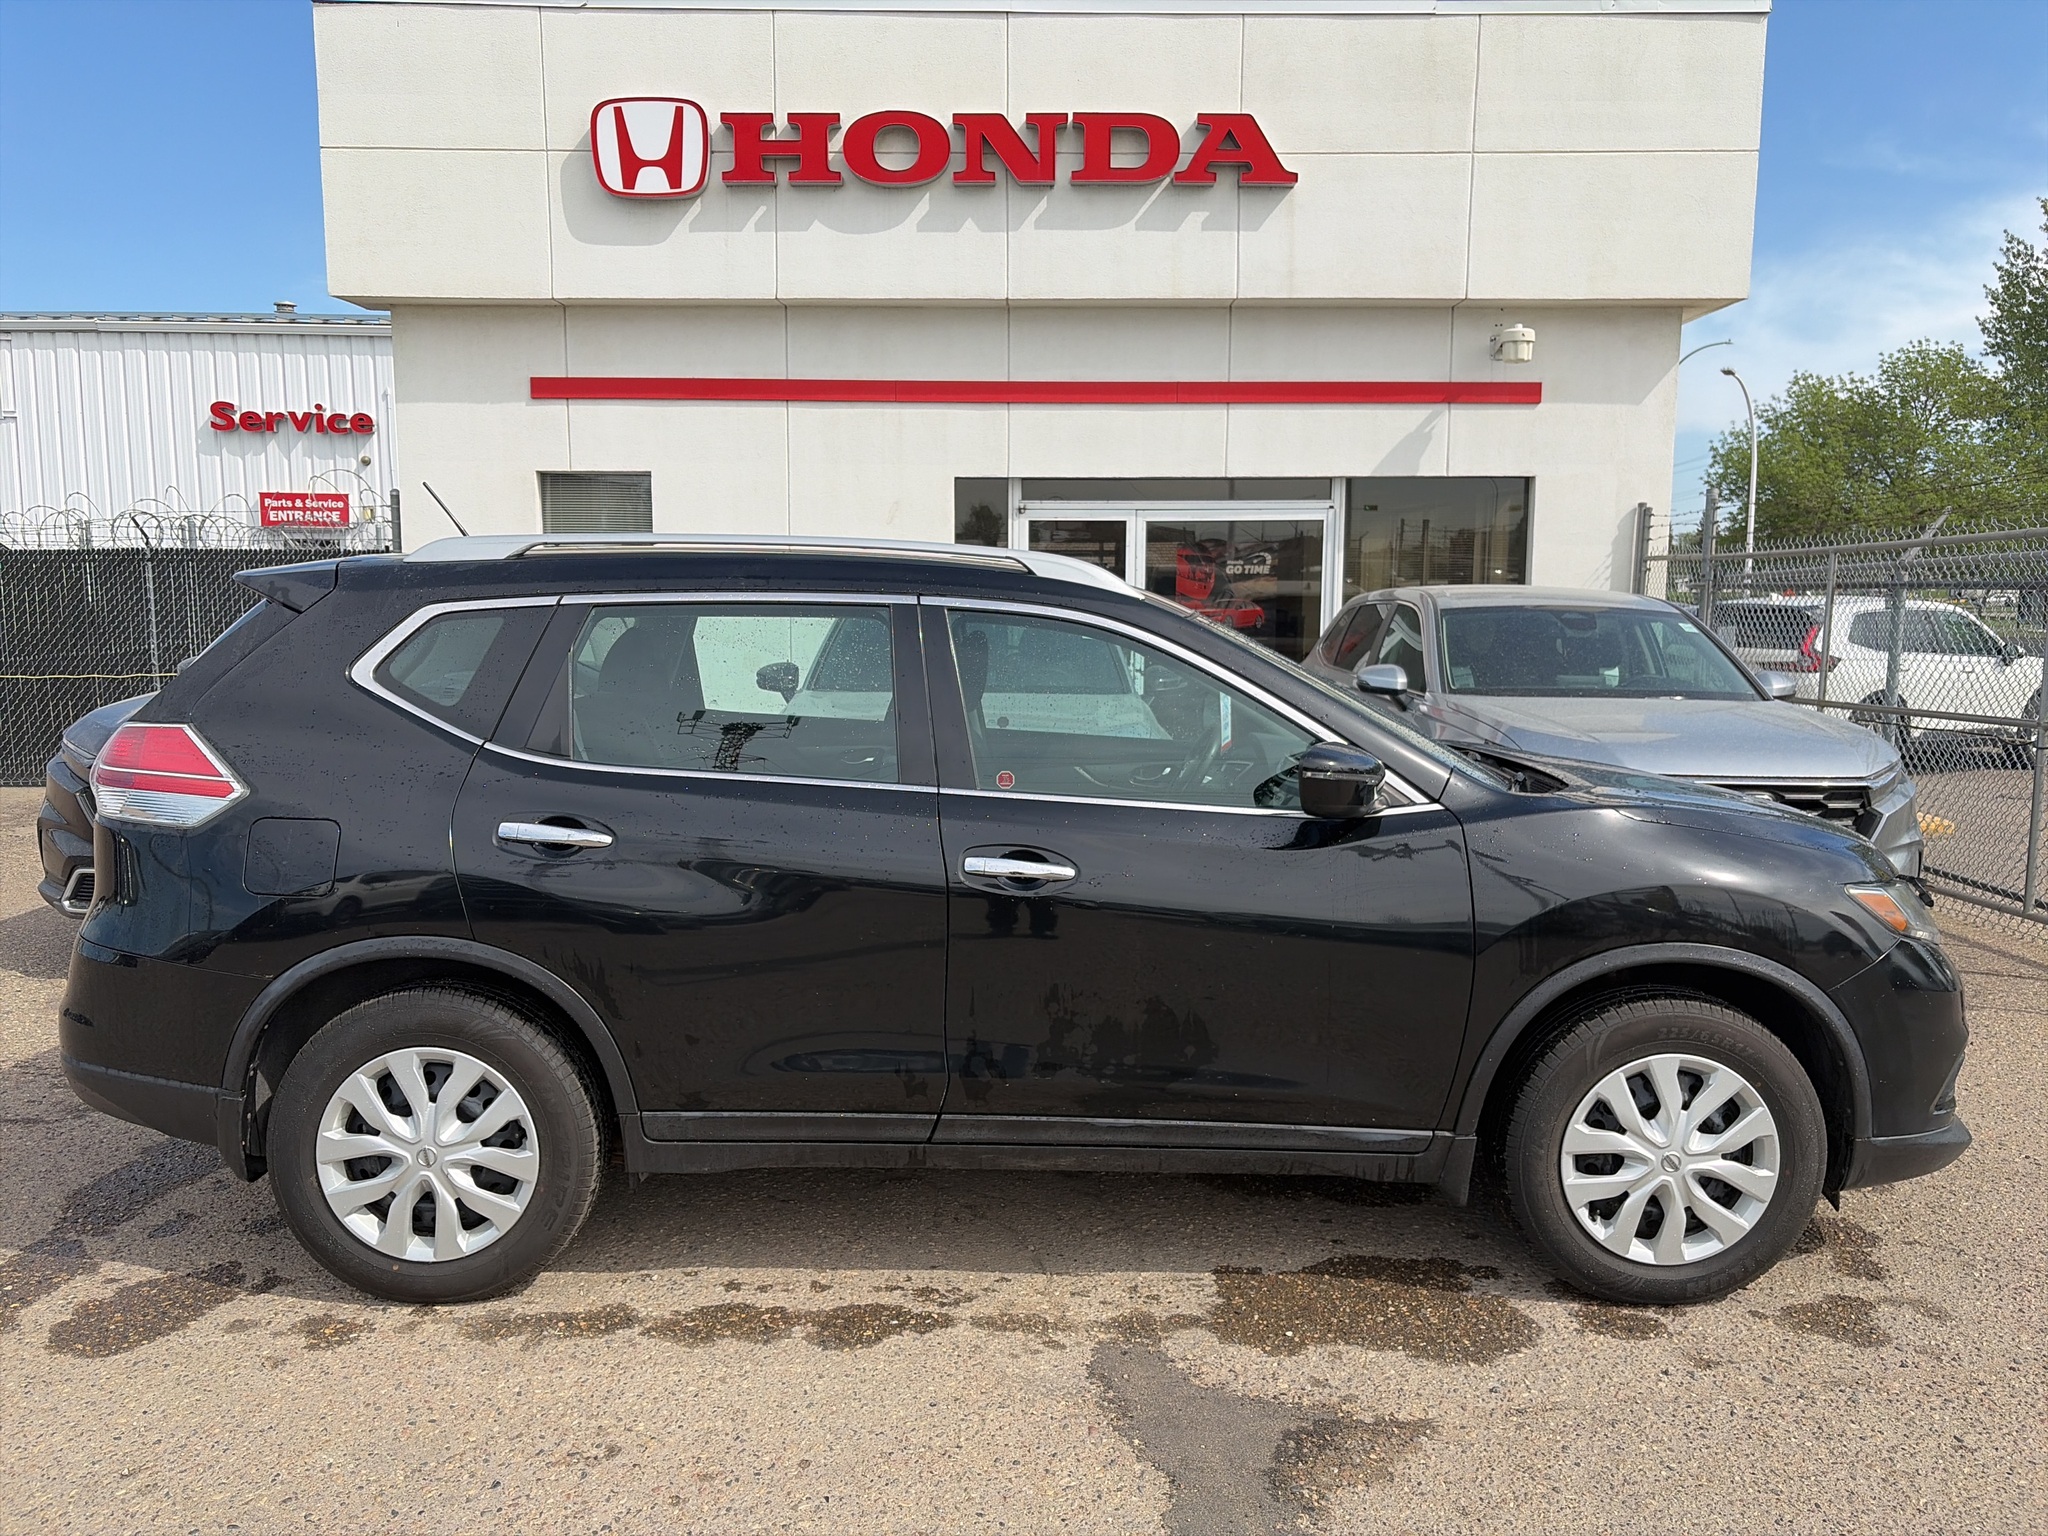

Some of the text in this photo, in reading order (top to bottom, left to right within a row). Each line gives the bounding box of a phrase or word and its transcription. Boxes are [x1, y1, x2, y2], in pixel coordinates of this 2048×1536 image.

[720, 110, 1299, 187] HONDA
[210, 401, 375, 435] Service
[264, 498, 344, 508] Parts & Service
[269, 510, 341, 522] ENTRANCE
[1225, 565, 1271, 575] GO TIME
